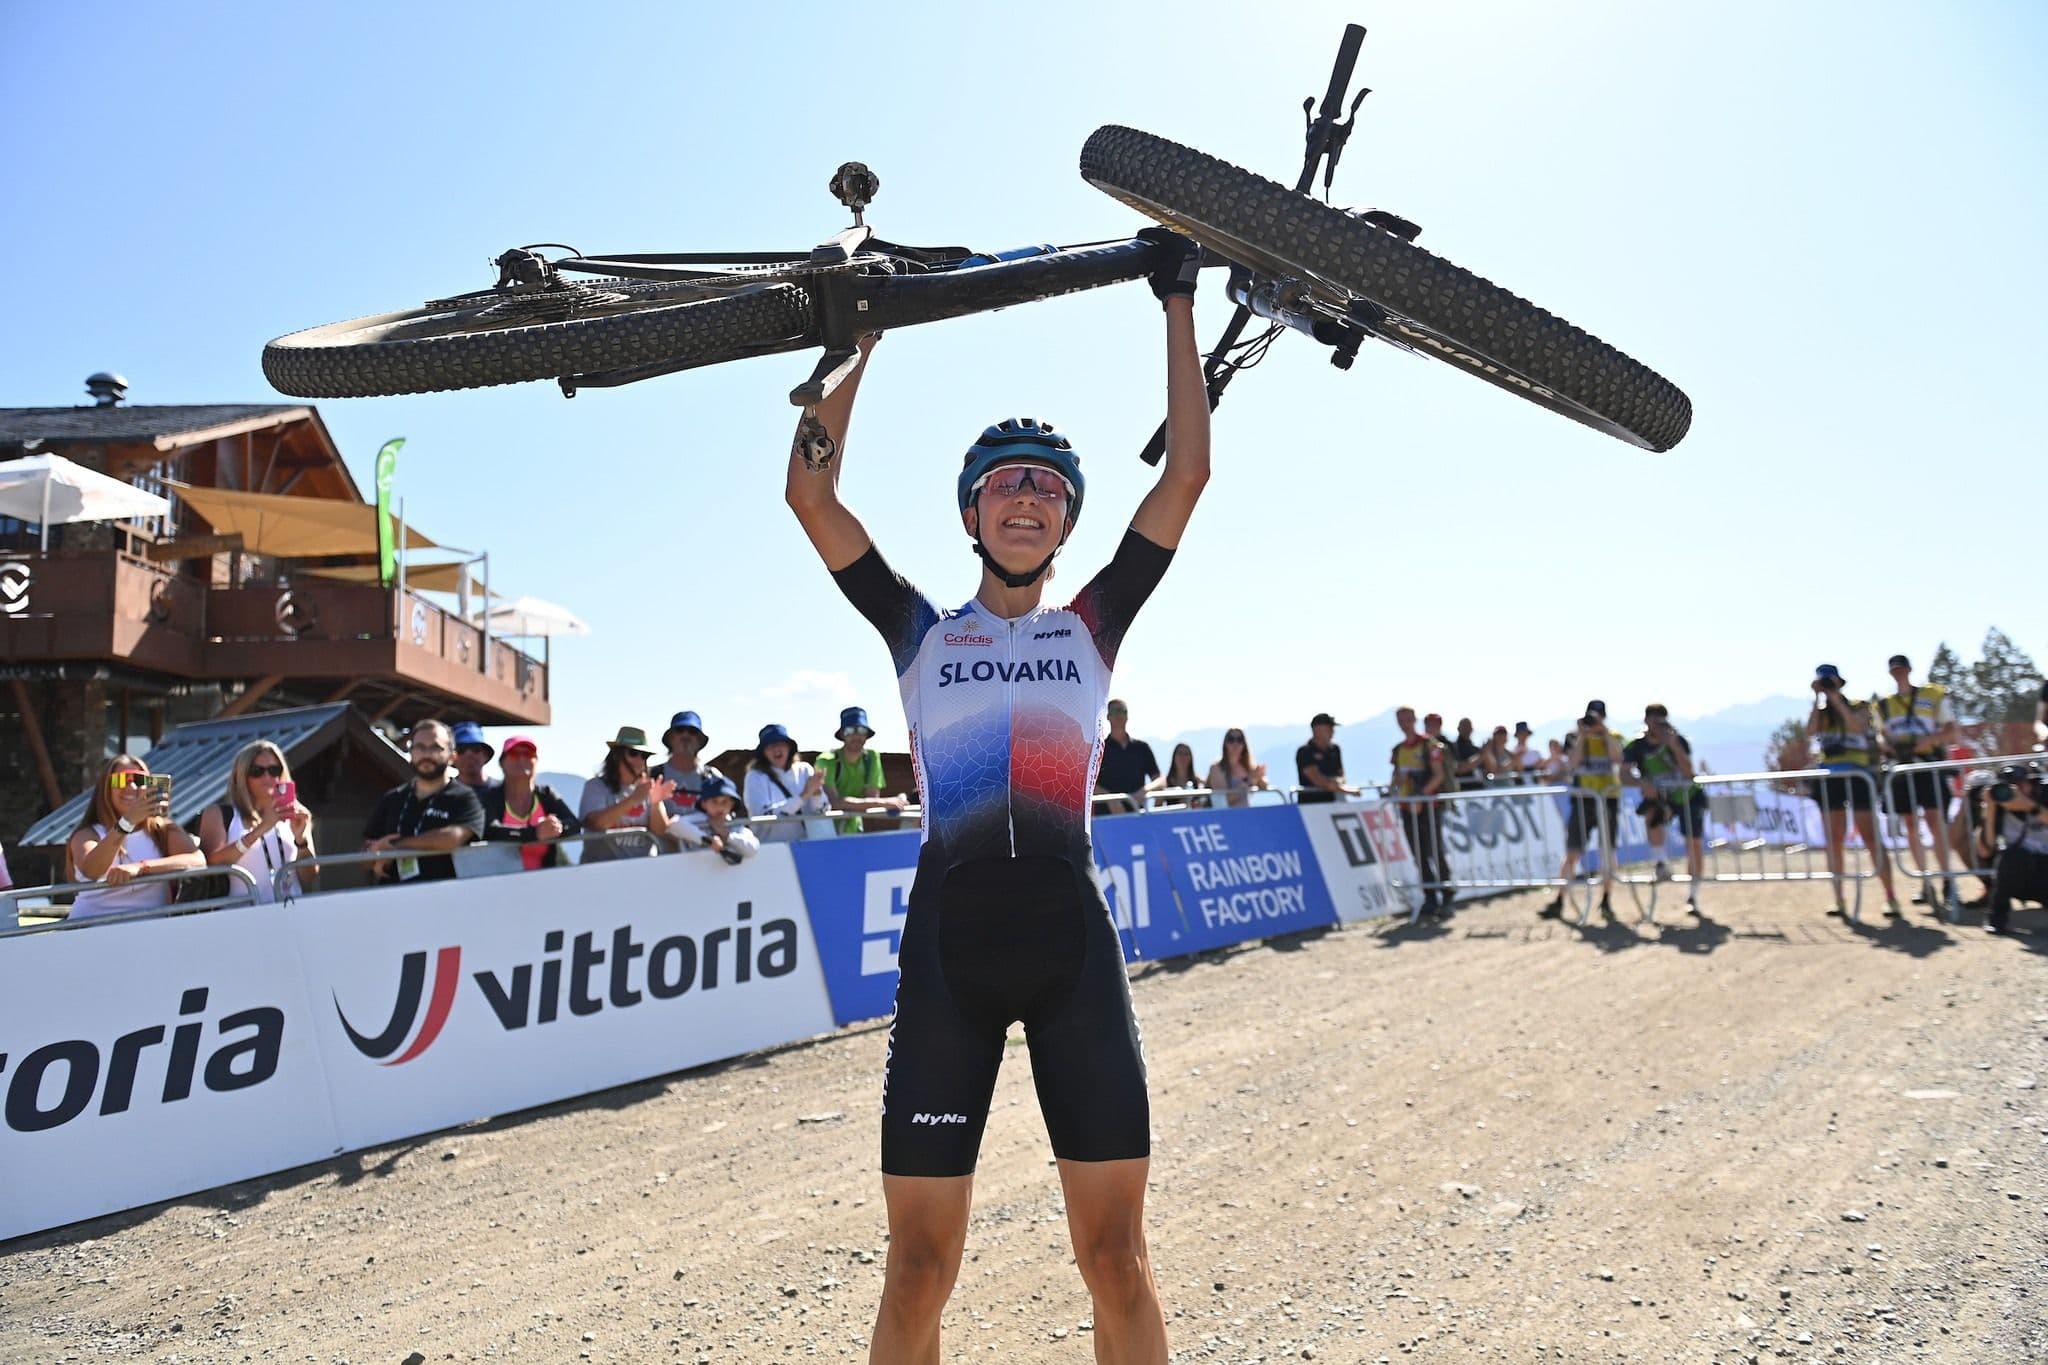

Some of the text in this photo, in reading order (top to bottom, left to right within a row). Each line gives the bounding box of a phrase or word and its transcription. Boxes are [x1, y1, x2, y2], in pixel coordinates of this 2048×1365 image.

[944, 633, 993, 644] Cofidis
[1033, 628, 1072, 640] NyNa
[939, 660, 1082, 687] SLOVAKIA
[1172, 823, 1229, 856] THE
[1187, 850, 1303, 892] RAINBOW
[1199, 885, 1307, 929] FACTORY
[473, 901, 798, 1031] vittoria
[0, 986, 285, 1132] oria
[911, 1112, 968, 1126] NyNa
